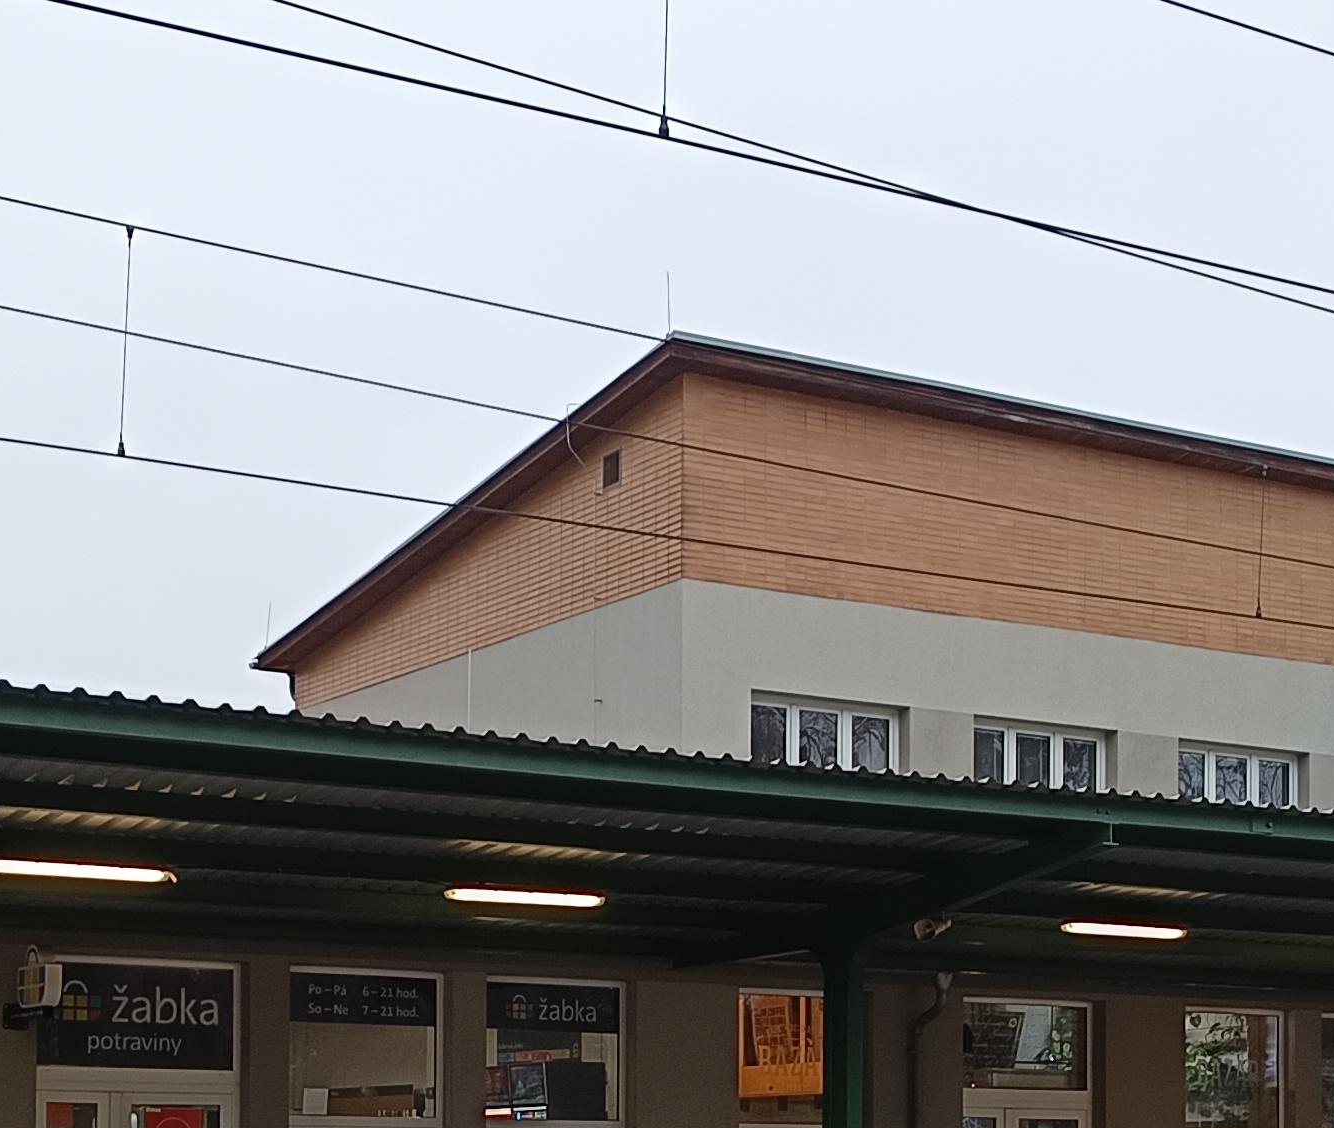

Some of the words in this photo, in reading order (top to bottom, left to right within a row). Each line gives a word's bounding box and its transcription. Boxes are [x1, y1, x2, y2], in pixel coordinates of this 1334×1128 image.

[308, 984, 322, 995] Po
[334, 984, 347, 996] Pá
[362, 986, 370, 997] 6
[380, 987, 393, 998] 21
[396, 987, 419, 999] hod.
[111, 984, 220, 1026] žabka
[308, 1003, 322, 1015] So
[333, 1004, 349, 1016] Ne
[362, 1005, 369, 1016] 7
[380, 1006, 393, 1017] 21
[396, 1006, 419, 1018] hod.
[538, 997, 597, 1022] žabka
[87, 1032, 183, 1056] potraviny
